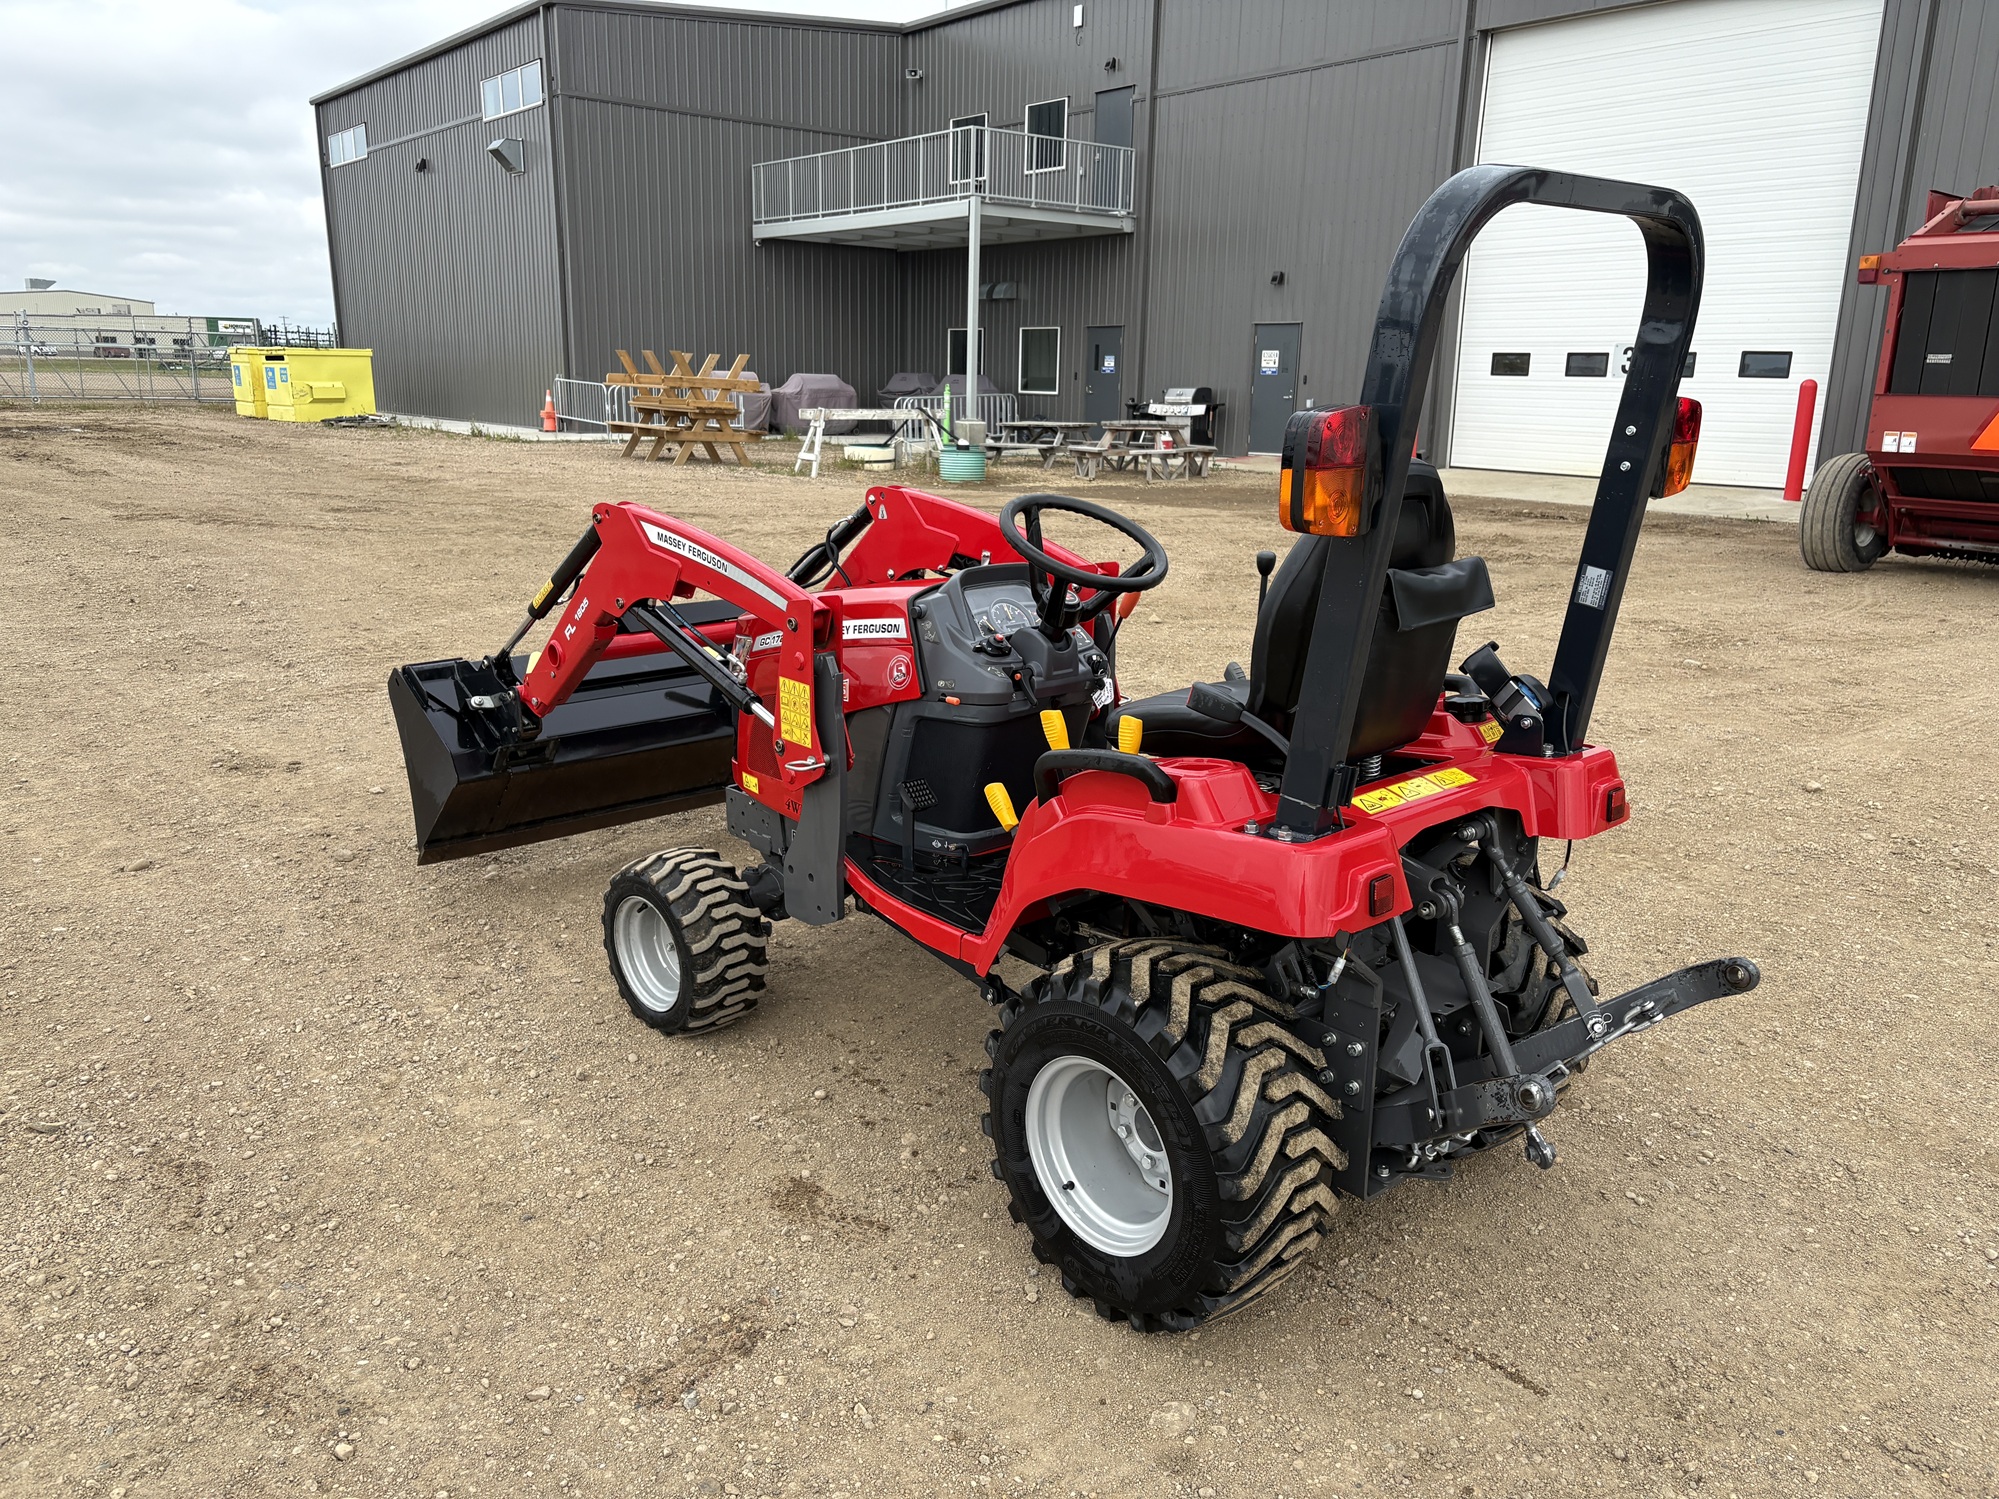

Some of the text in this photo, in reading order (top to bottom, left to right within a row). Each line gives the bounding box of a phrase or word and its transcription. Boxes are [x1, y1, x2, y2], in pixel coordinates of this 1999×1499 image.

[657, 531, 728, 573] MASSEY FERGUSON
[564, 597, 589, 641] FL 1805
[853, 624, 900, 634] FERGUSON
